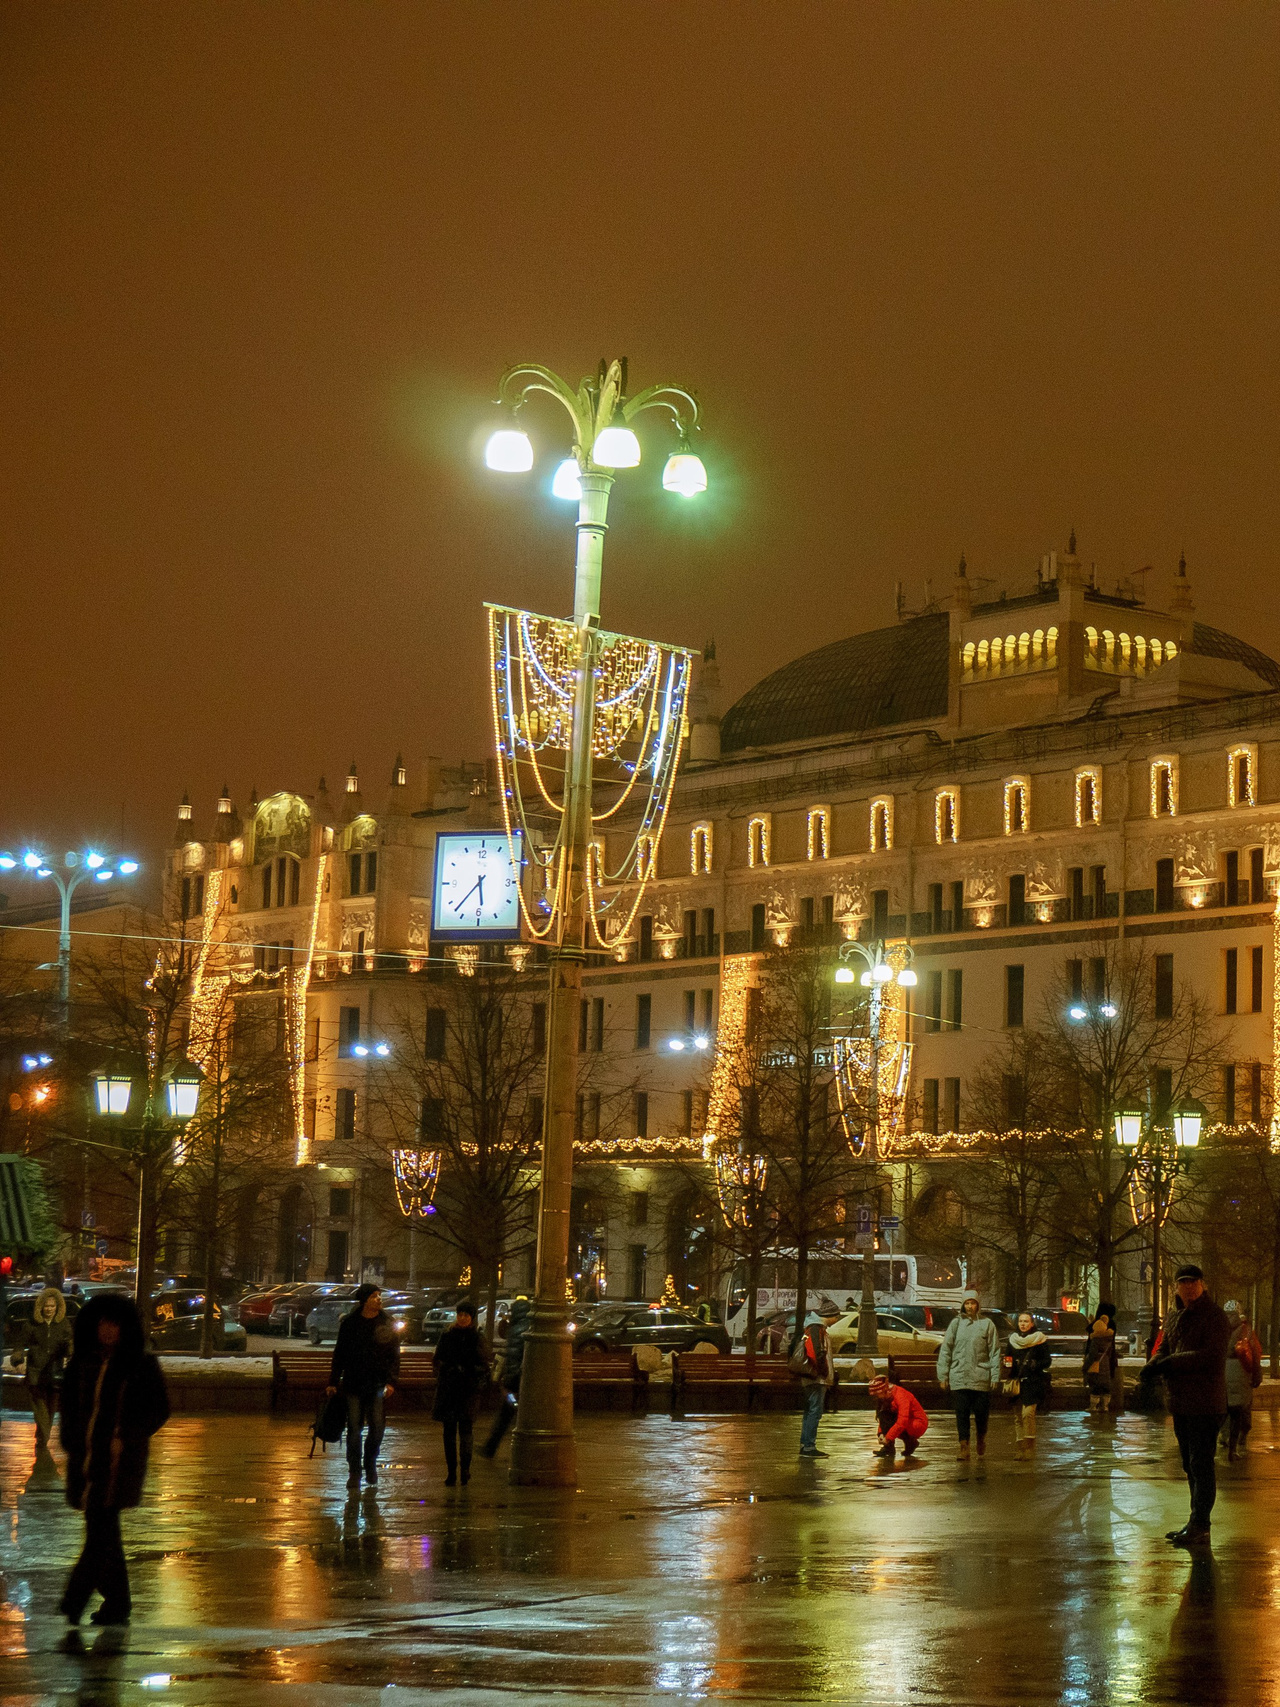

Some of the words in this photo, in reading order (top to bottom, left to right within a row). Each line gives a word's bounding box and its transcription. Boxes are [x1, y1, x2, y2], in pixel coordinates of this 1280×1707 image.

[478, 850, 487, 859] 12
[452, 880, 458, 888] 9
[505, 878, 511, 887] 3
[475, 908, 482, 917] 6
